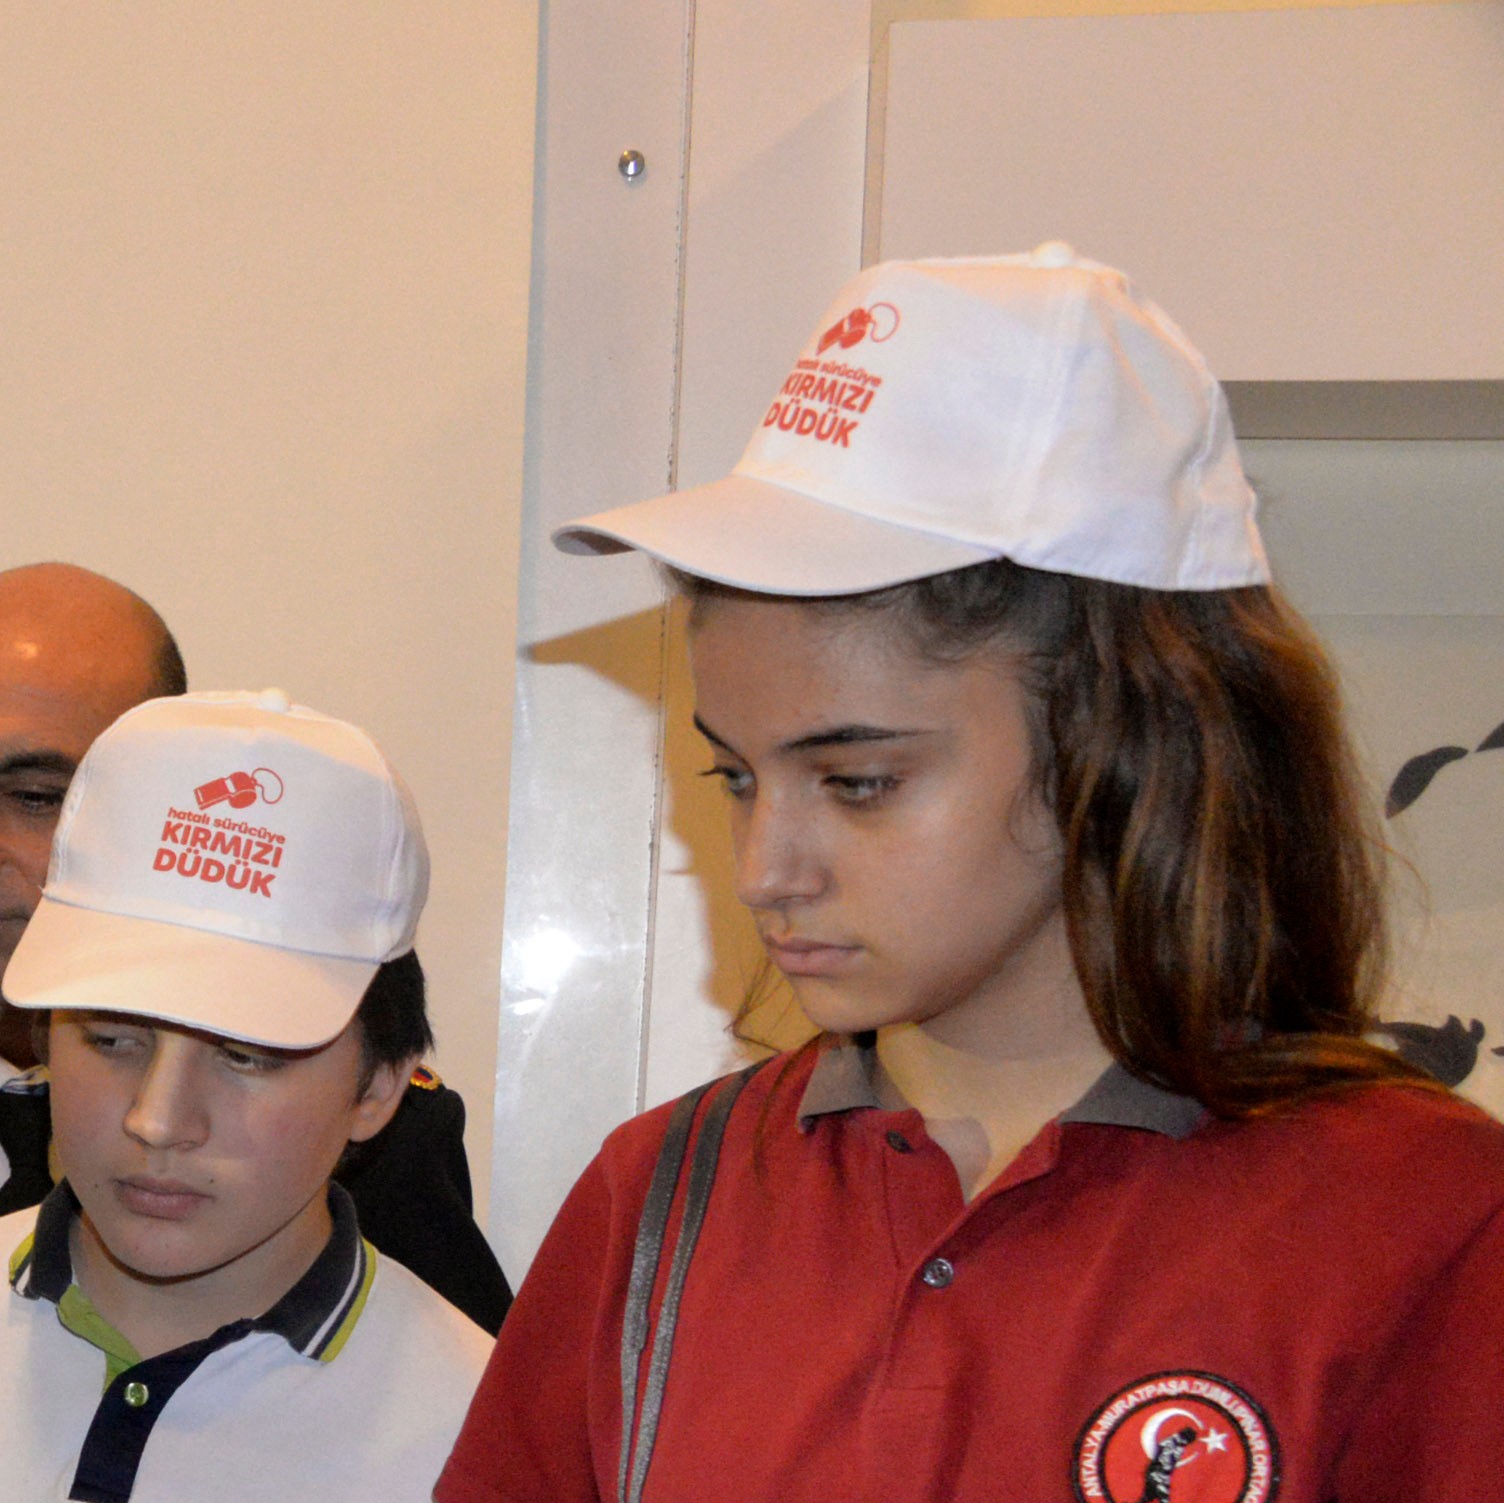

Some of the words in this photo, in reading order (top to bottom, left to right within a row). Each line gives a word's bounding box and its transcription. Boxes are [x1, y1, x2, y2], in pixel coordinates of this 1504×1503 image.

[763, 398, 858, 447] DÜDÜK
[161, 821, 283, 868] KIRMIZI
[167, 806, 211, 826] hatalı
[213, 817, 286, 845] sürücüye
[153, 847, 276, 898] DÜDÜK
